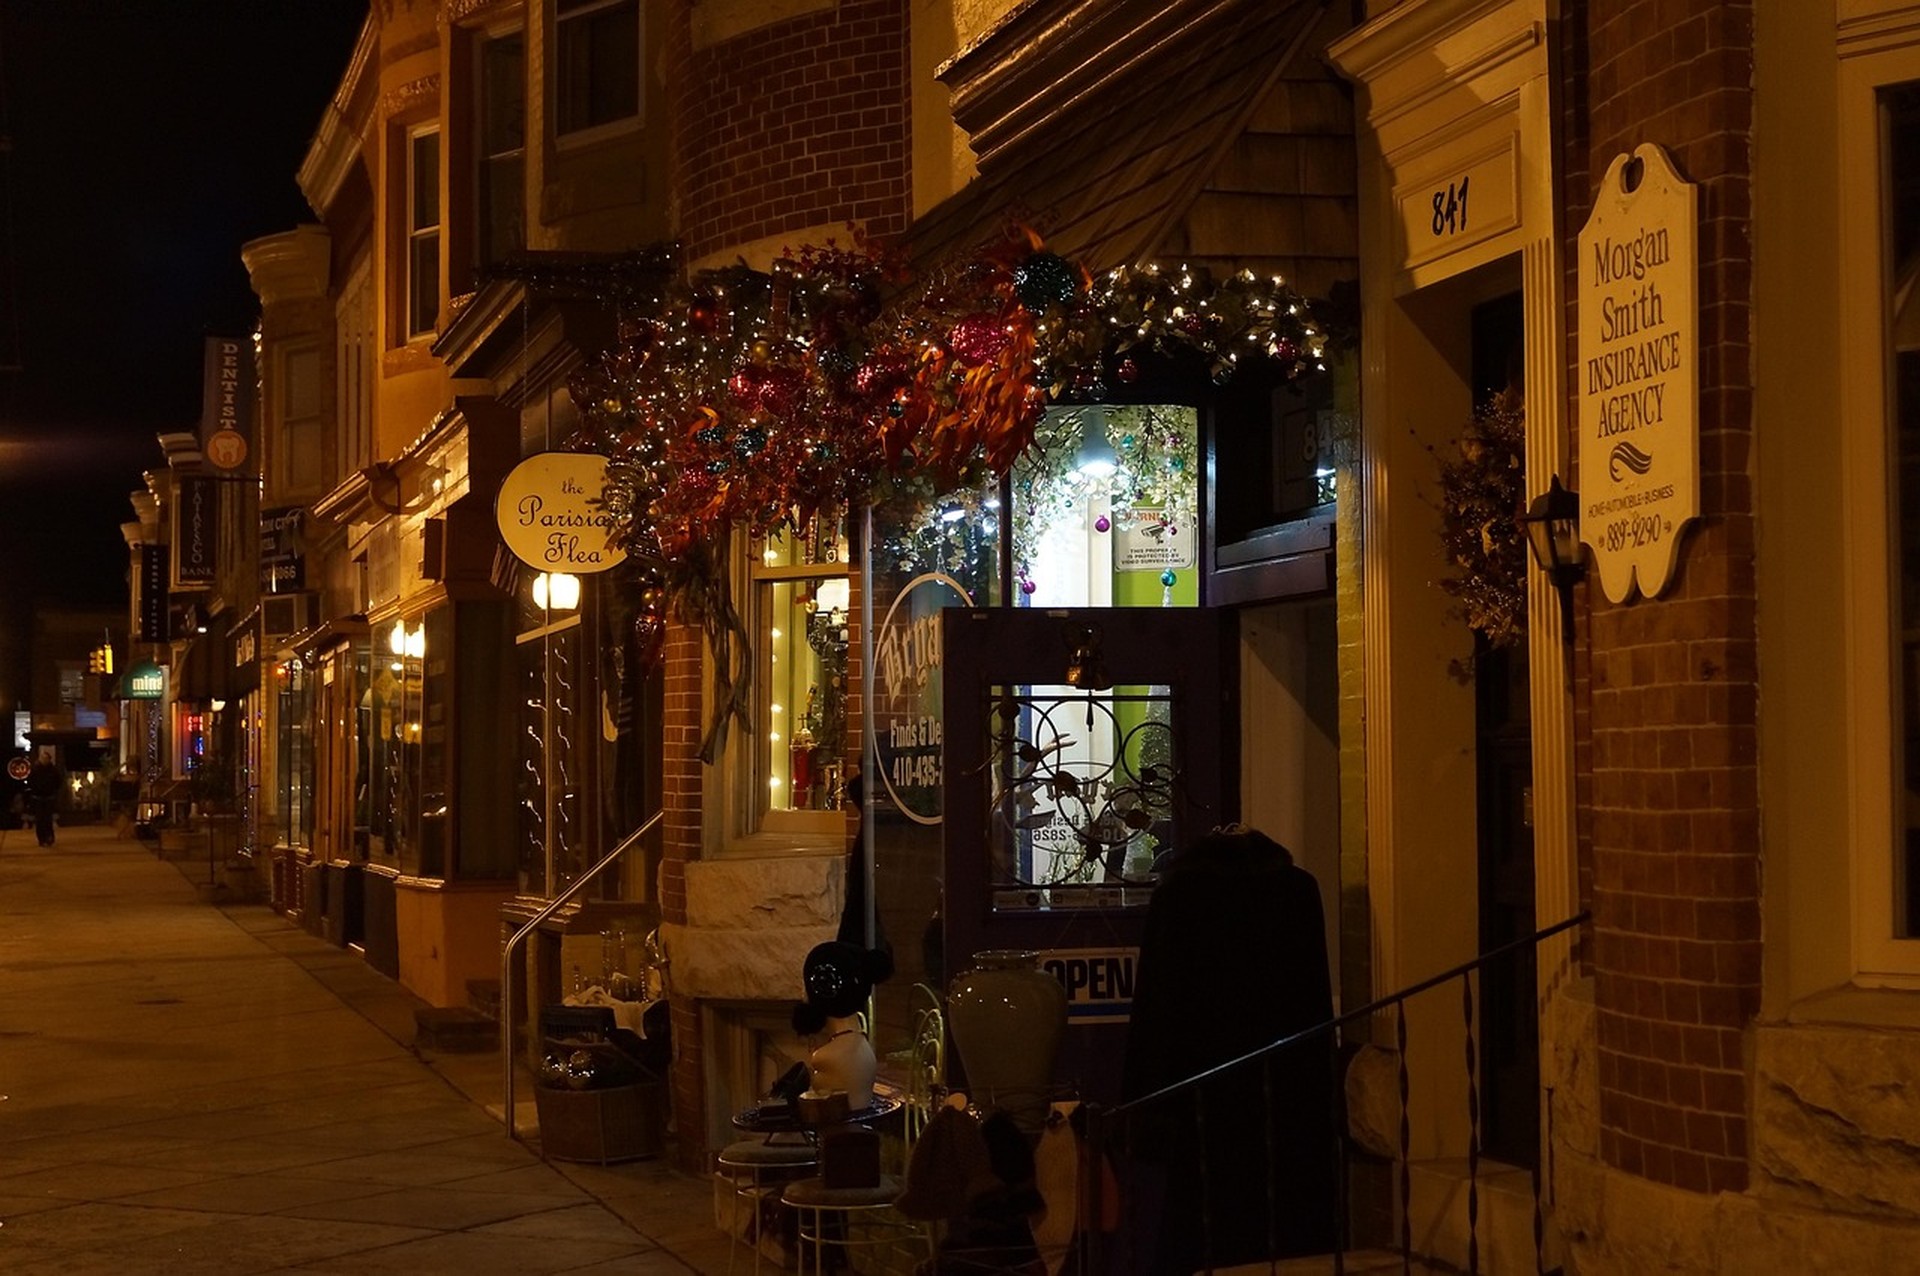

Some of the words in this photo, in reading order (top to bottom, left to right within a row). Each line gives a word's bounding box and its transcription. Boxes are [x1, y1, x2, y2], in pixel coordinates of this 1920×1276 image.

[1432, 176, 1469, 236] 841
[1593, 226, 1671, 289] Morgan
[1600, 280, 1665, 344] Smith
[220, 342, 239, 430] DENTIST
[1587, 330, 1681, 396] INSURANCE
[1596, 382, 1667, 439] AGENCY
[517, 494, 610, 527] Parisia
[561, 476, 585, 495] the
[544, 531, 602, 563] Flea
[1606, 513, 1661, 553] 889-9290
[181, 566, 215, 577] BANK
[881, 613, 942, 711] Brya
[890, 718, 917, 748] Finds
[928, 715, 942, 746] De
